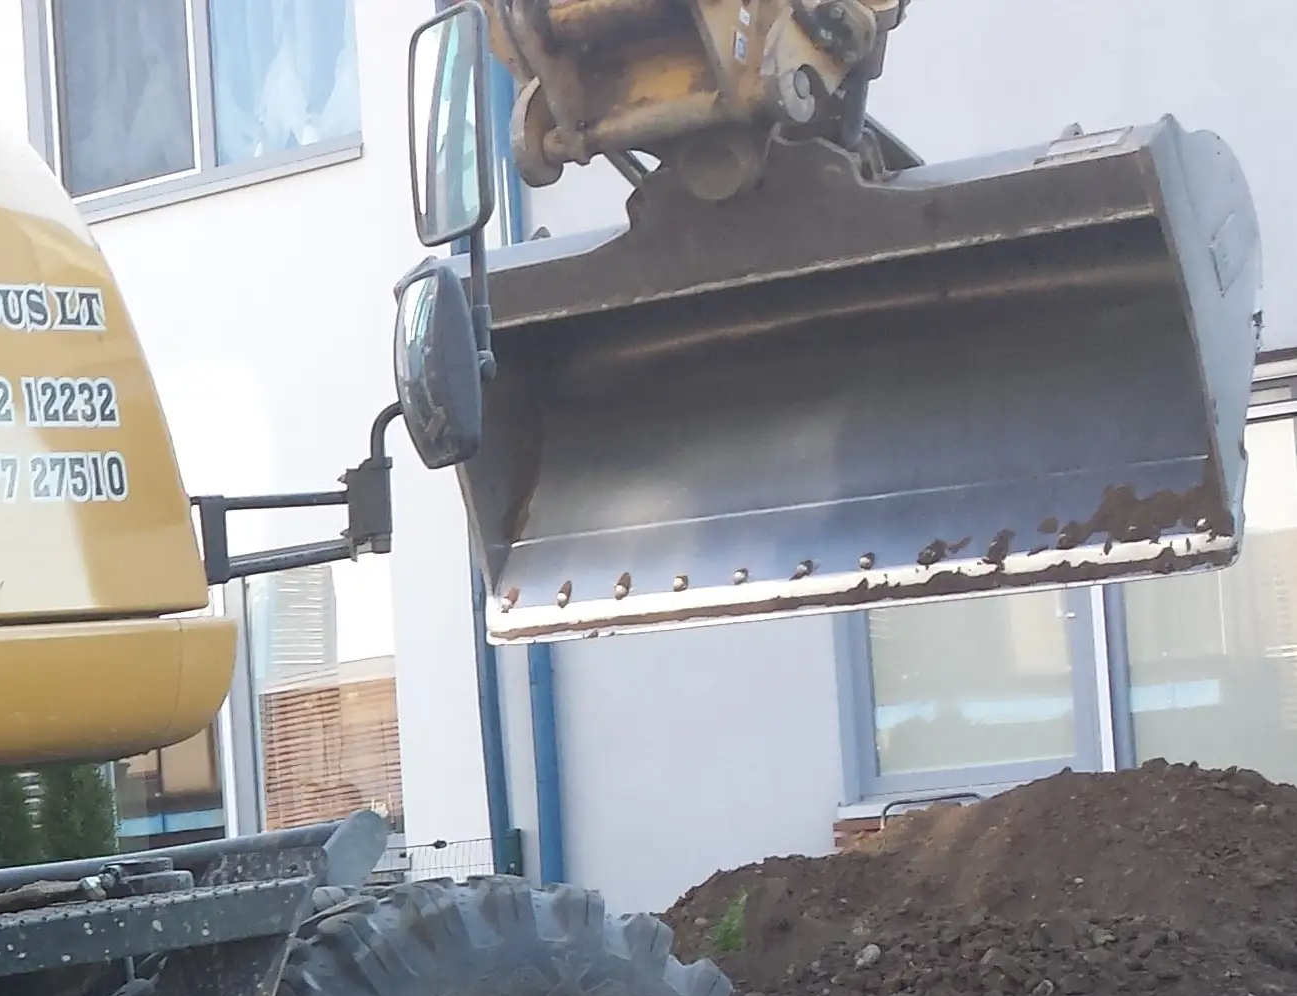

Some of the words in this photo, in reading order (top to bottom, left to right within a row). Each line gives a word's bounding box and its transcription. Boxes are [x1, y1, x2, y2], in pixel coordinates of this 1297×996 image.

[54, 289, 104, 328] LT
[22, 379, 117, 424] 12232
[30, 457, 126, 502] 27510
